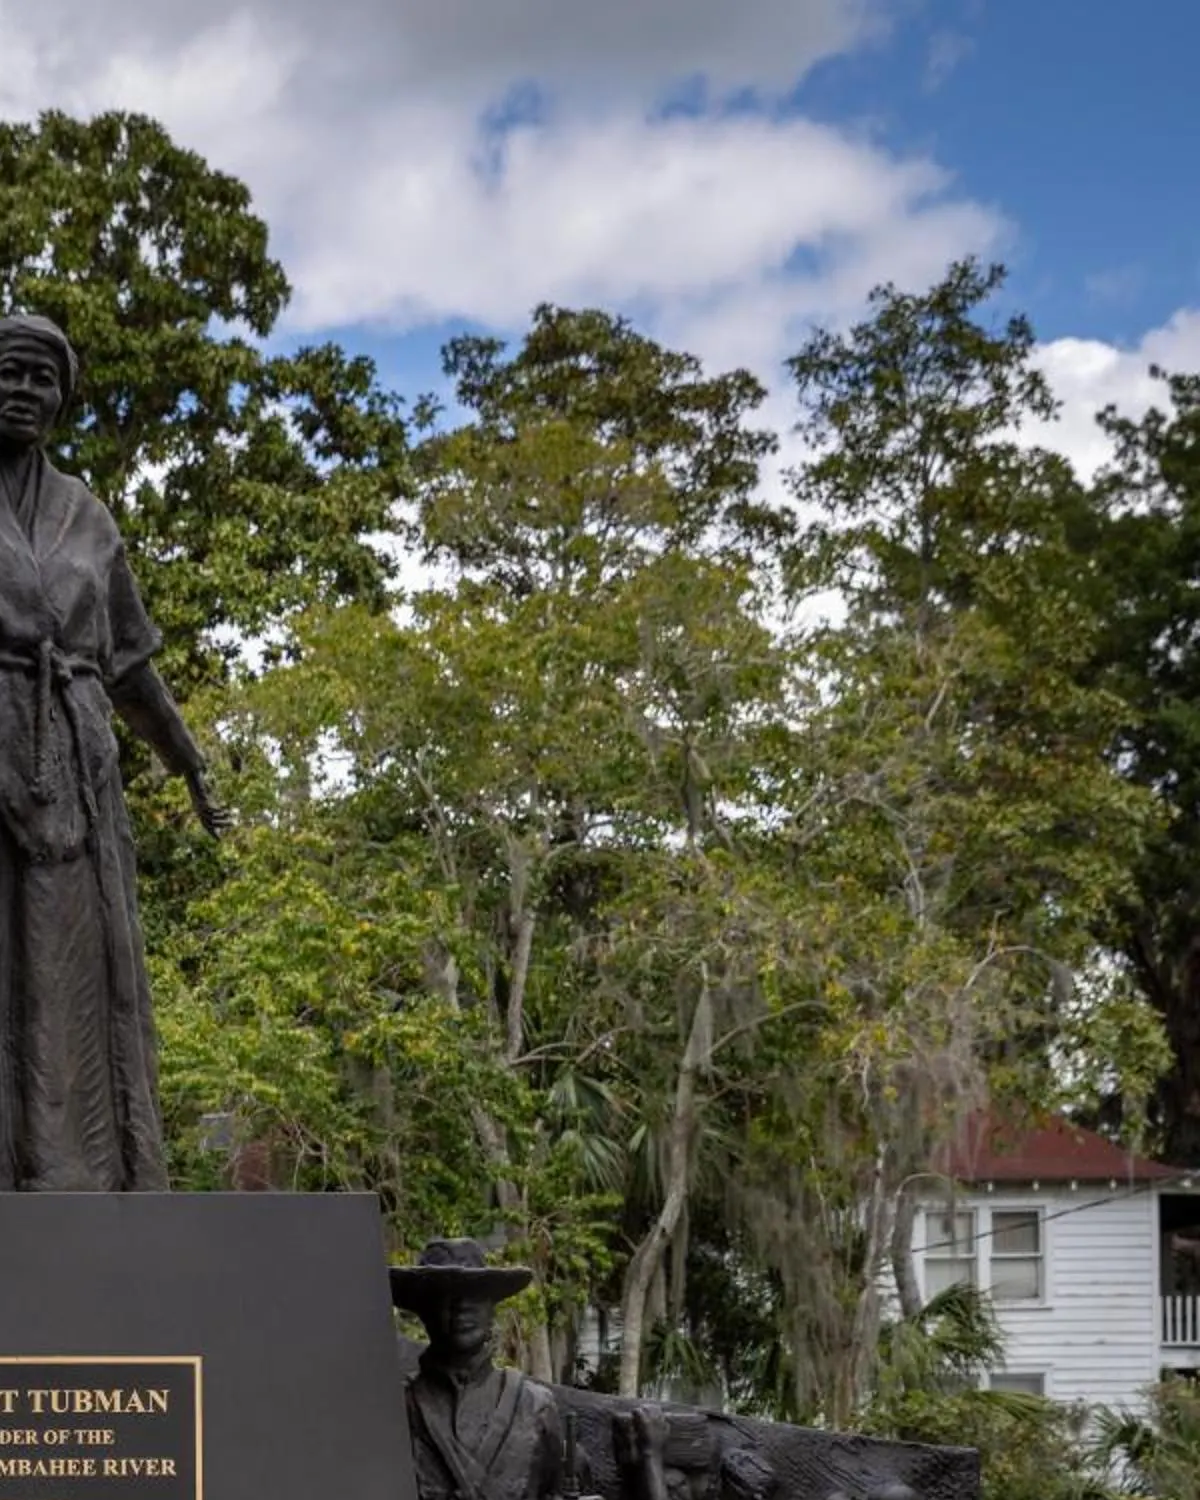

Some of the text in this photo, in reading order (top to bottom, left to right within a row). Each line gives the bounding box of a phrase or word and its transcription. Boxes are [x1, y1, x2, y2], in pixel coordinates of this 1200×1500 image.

[27, 1389, 170, 1413] TUBMAN
[43, 1430, 70, 1445] OF
[73, 1430, 115, 1445] THE
[103, 1459, 177, 1476] RIVER
